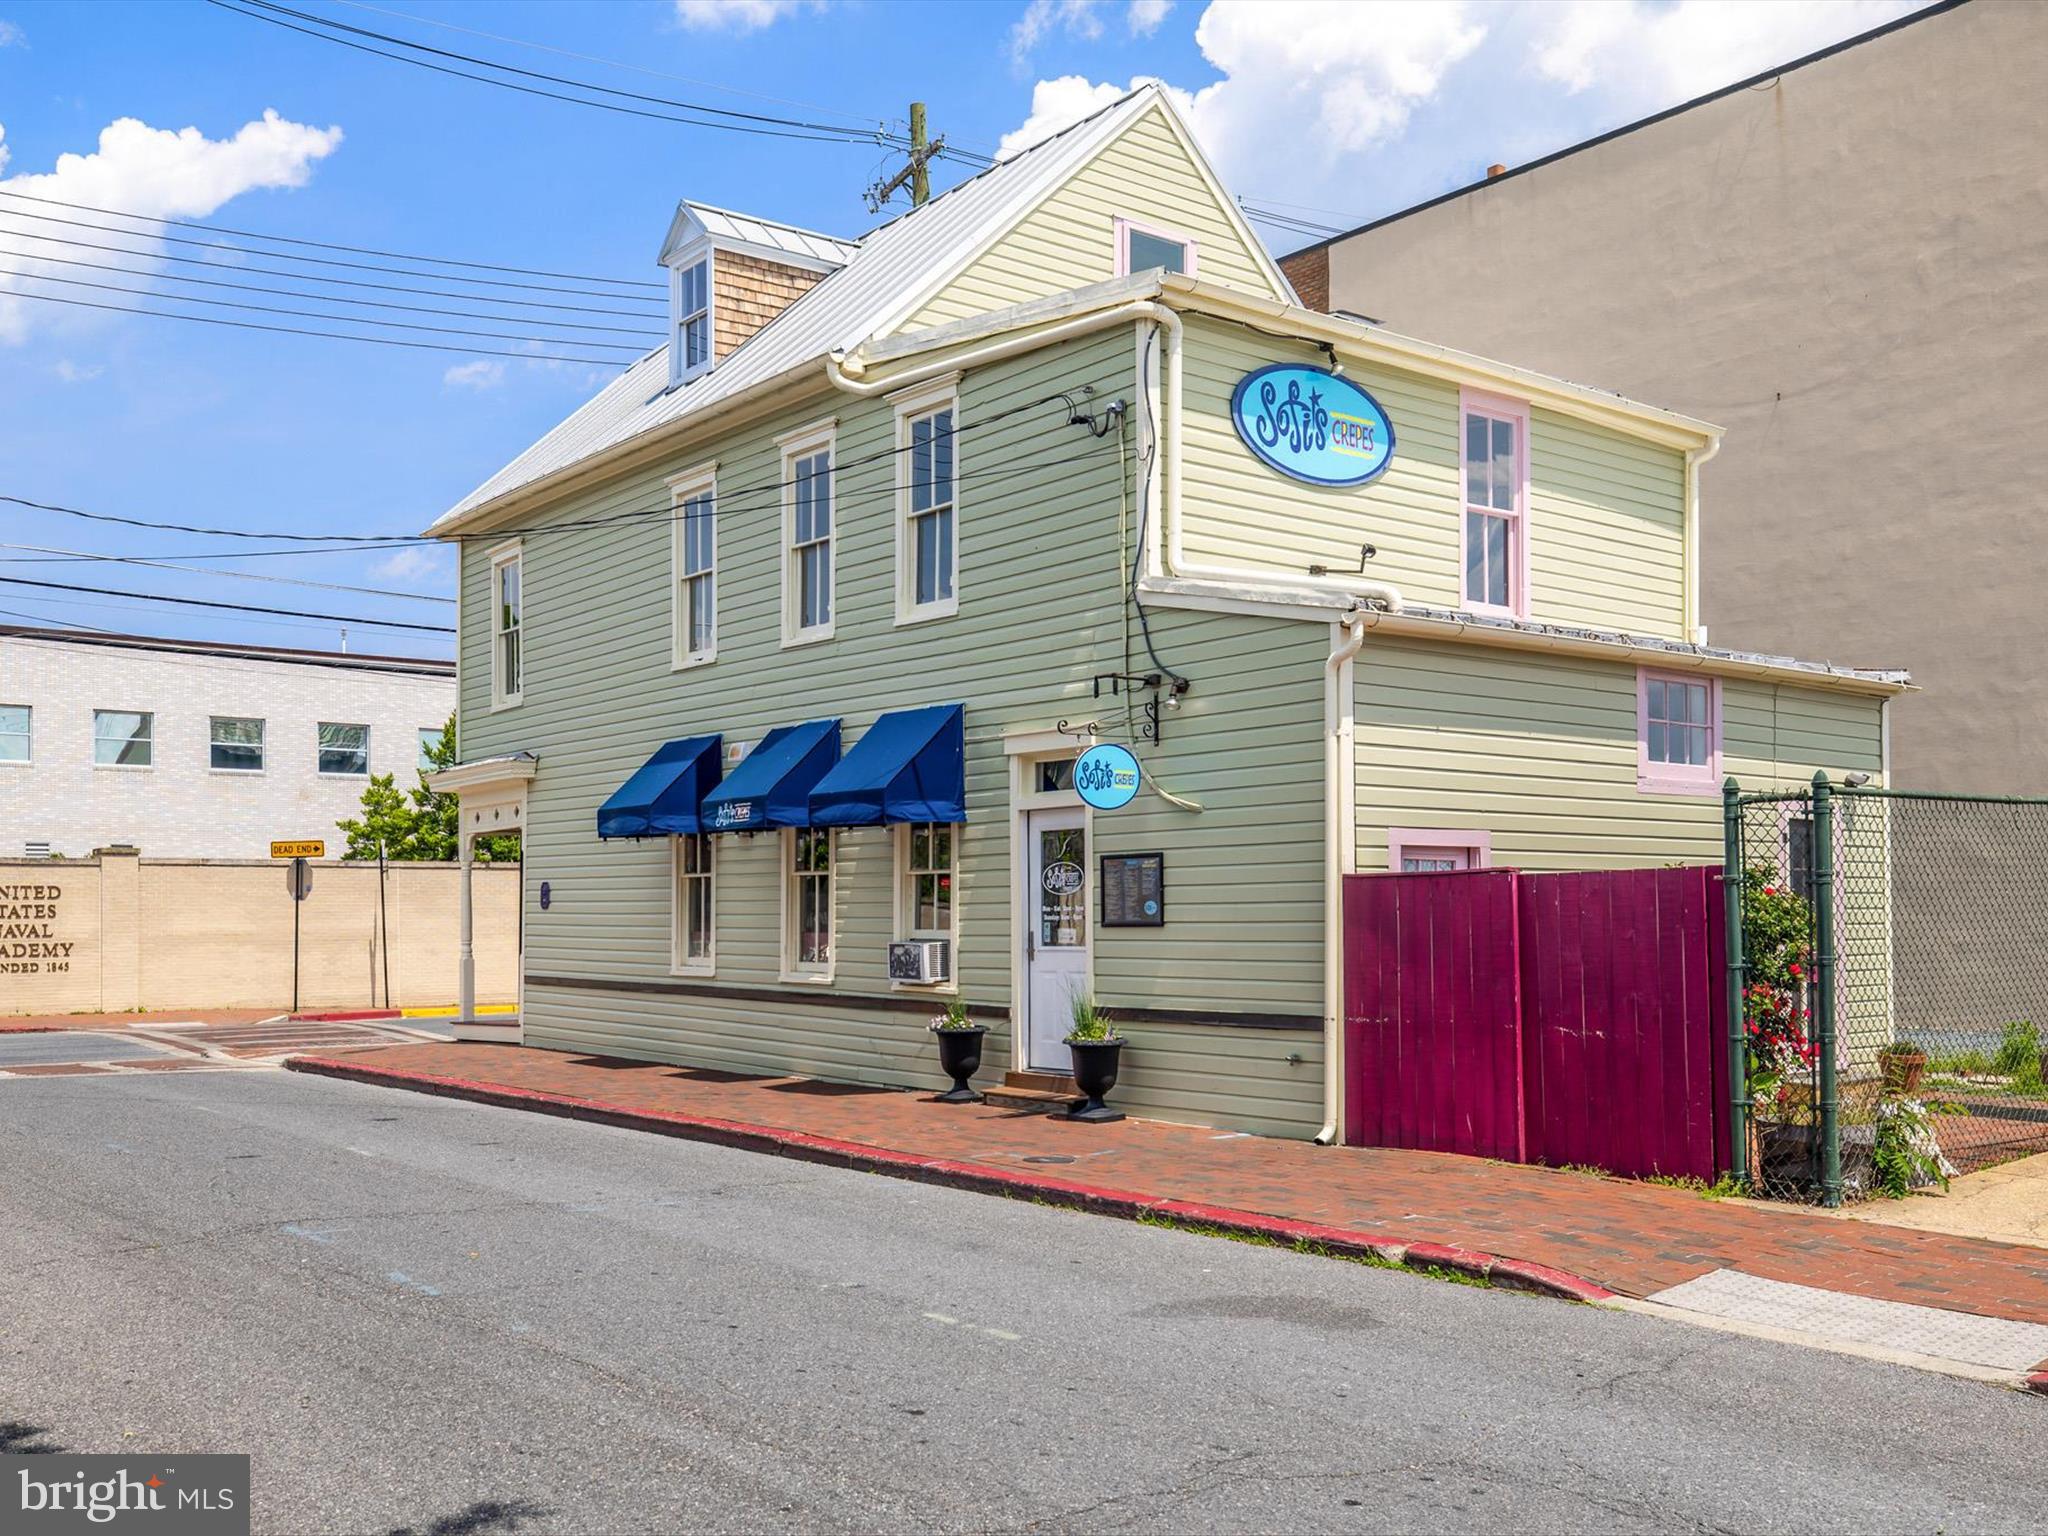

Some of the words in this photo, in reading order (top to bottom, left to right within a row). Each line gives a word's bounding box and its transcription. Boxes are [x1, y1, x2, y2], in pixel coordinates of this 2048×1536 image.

[1331, 419, 1375, 452] CREPES
[273, 845, 293, 854] DEAD
[296, 845, 312, 853] END
[0, 923, 54, 939] AVAL
[46, 961, 70, 973] 1845
